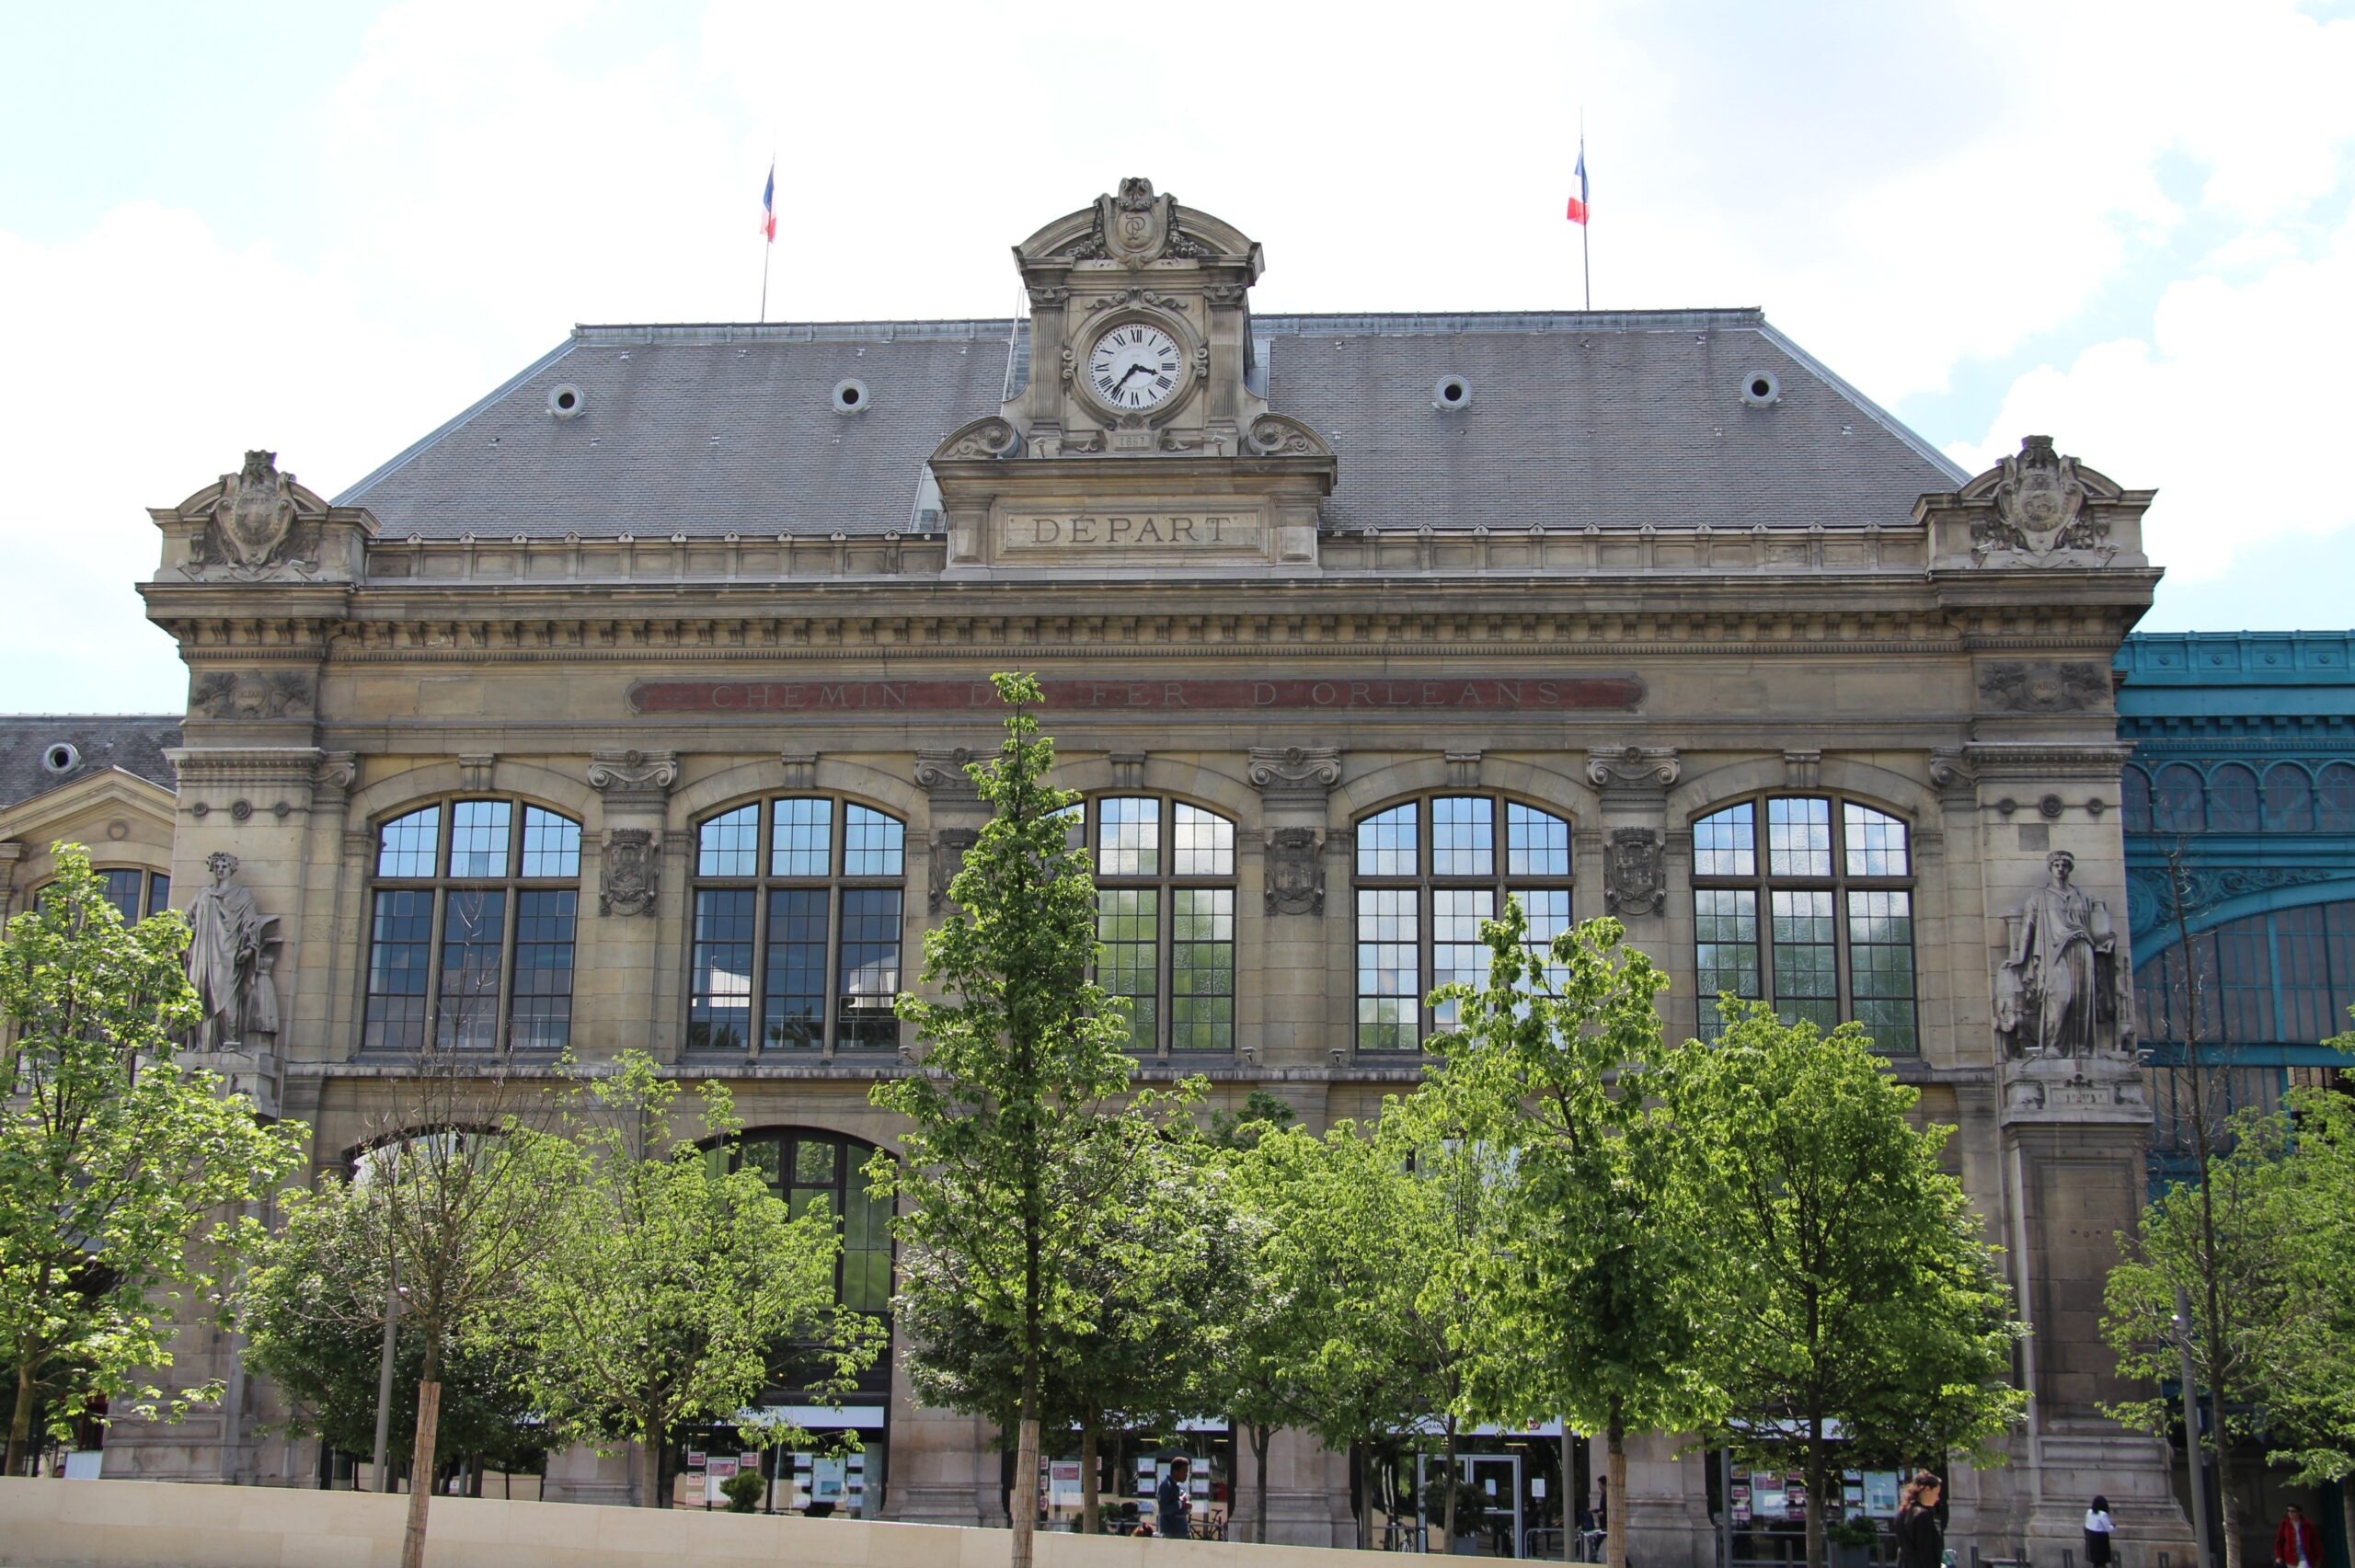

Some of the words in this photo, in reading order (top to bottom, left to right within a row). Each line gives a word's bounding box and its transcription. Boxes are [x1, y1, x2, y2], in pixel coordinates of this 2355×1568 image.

[1112, 333, 1126, 348] XI
[1130, 329, 1143, 343] XII
[1148, 334, 1157, 346] I
[1157, 346, 1172, 356] II
[1095, 363, 1109, 372] IX
[1155, 375, 1173, 390] IIII
[1131, 391, 1140, 406] VI
[1147, 388, 1157, 401] V
[1119, 436, 1145, 447] 1867
[1030, 514, 1231, 544] DÉPART
[2030, 679, 2058, 691] PARIS
[712, 684, 909, 708] CHEMIN
[1090, 682, 1189, 706] FER
